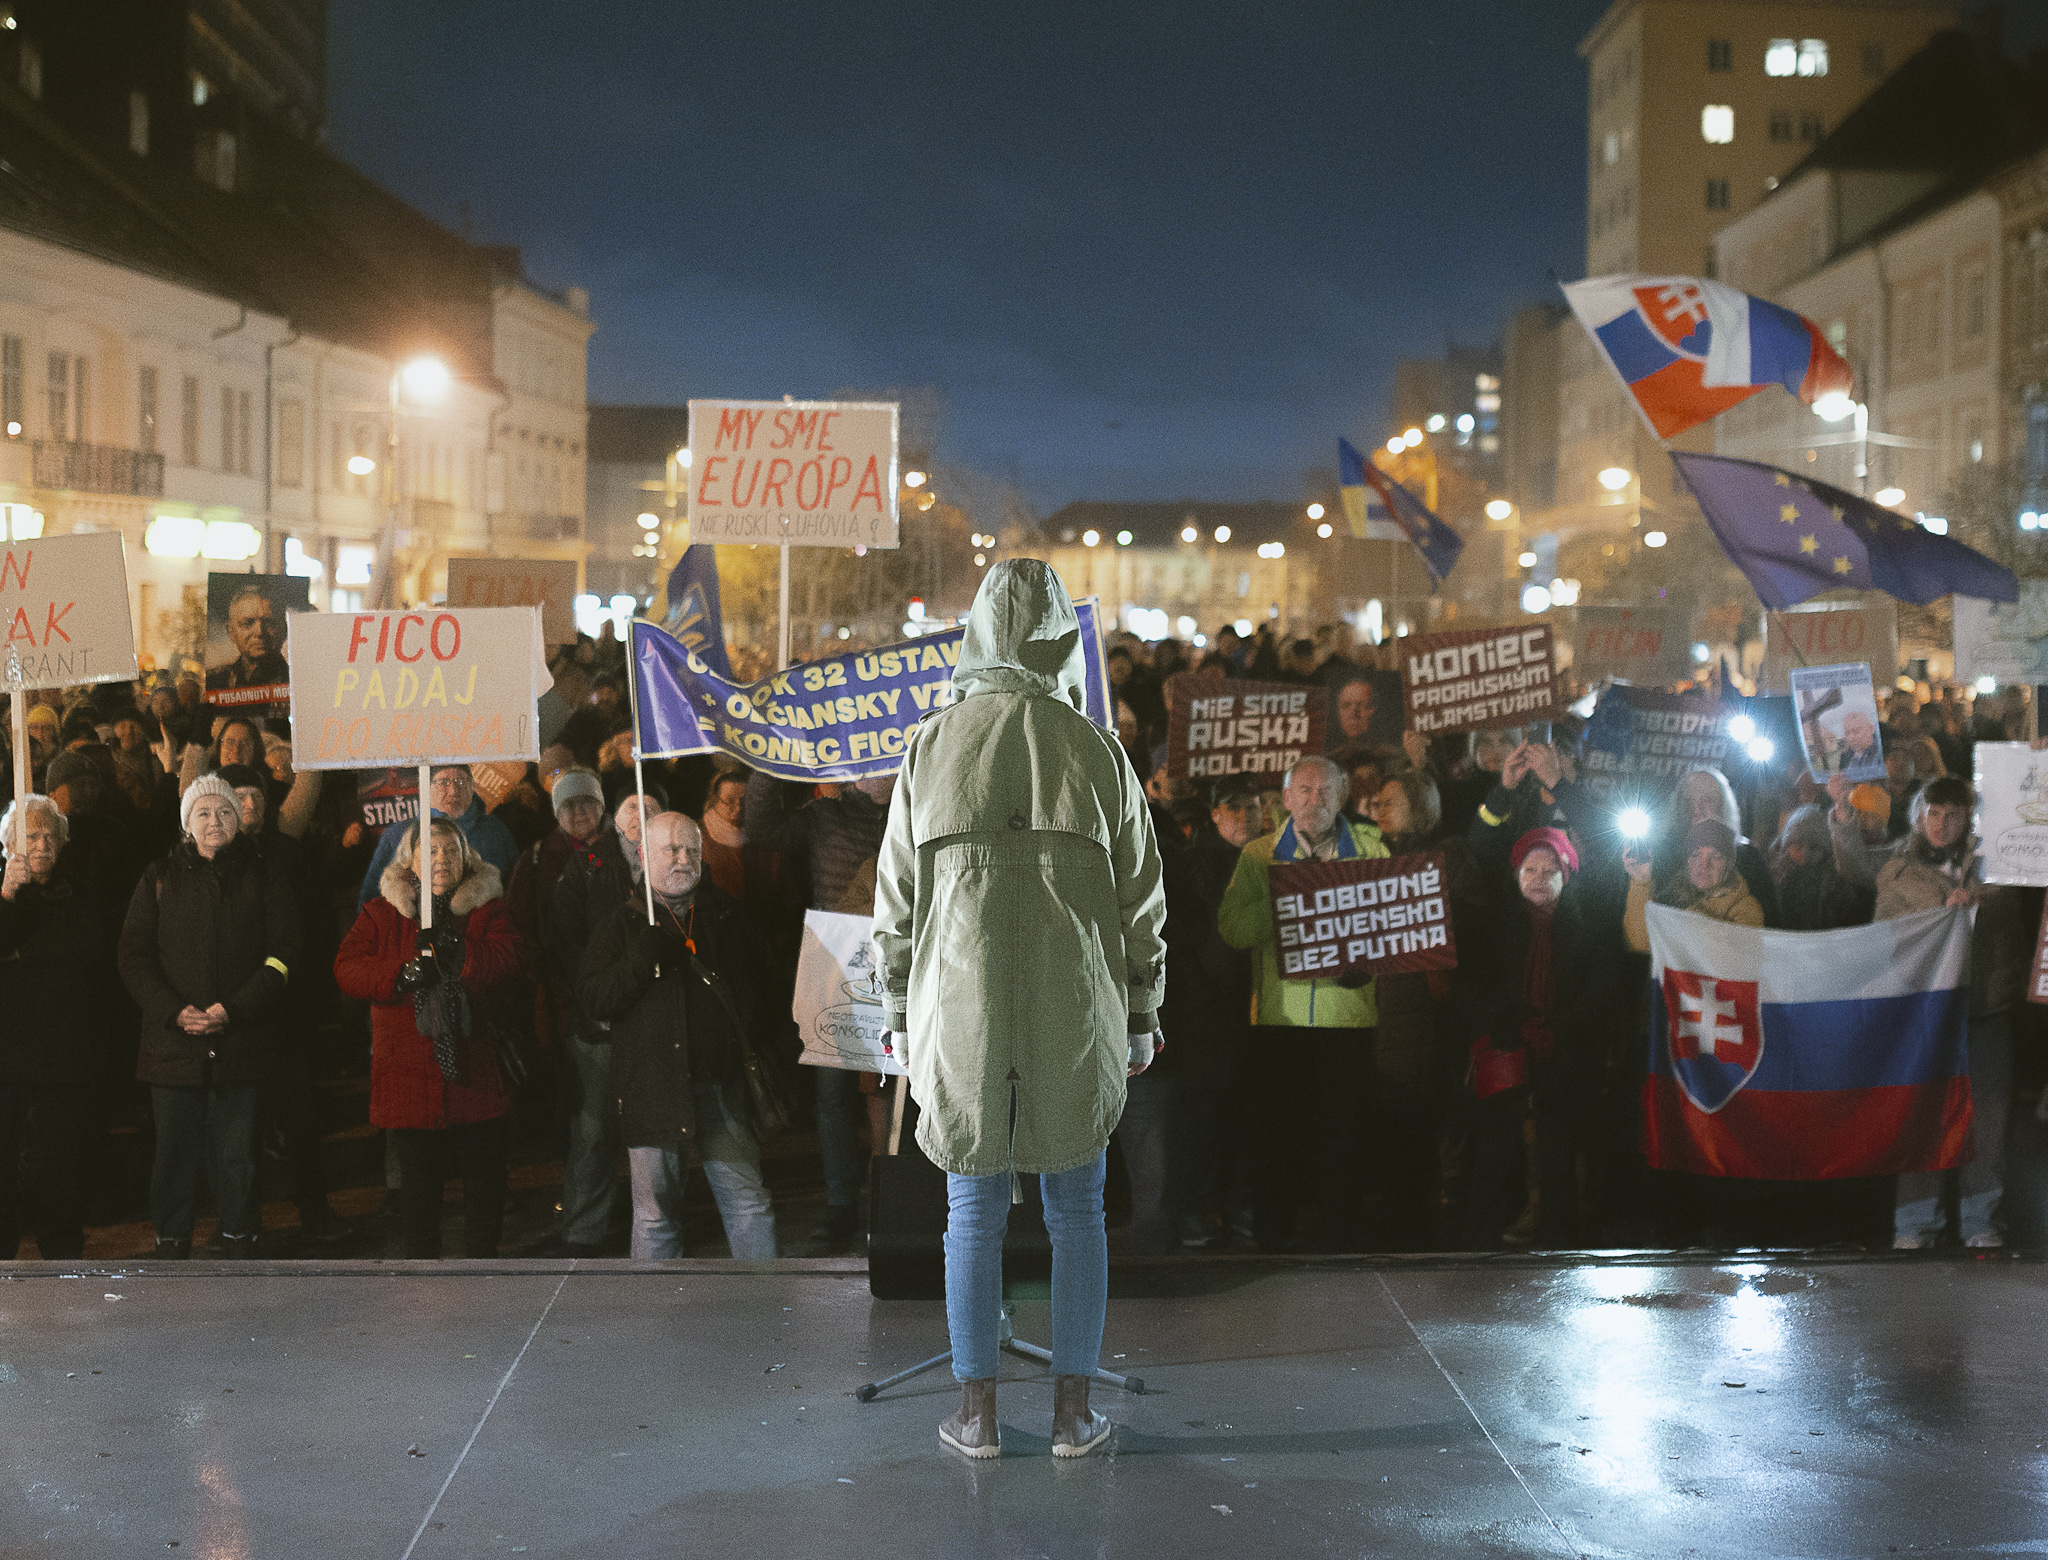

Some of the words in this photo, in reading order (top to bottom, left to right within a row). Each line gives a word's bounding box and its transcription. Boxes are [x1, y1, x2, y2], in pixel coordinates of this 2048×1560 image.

[715, 408, 763, 451] MY
[769, 409, 841, 451] SME
[698, 454, 882, 512] EURÓPA
[348, 614, 461, 664] FICO
[334, 665, 477, 709] PADAJ
[803, 662, 847, 691] 32
[317, 717, 371, 758] DO
[385, 713, 504, 756] RUSKA
[724, 723, 841, 764] KONIEC
[1280, 898, 1445, 948] SLOVENSKO
[1284, 944, 1340, 974] BEZ
[1347, 924, 1447, 963] PUTINA
